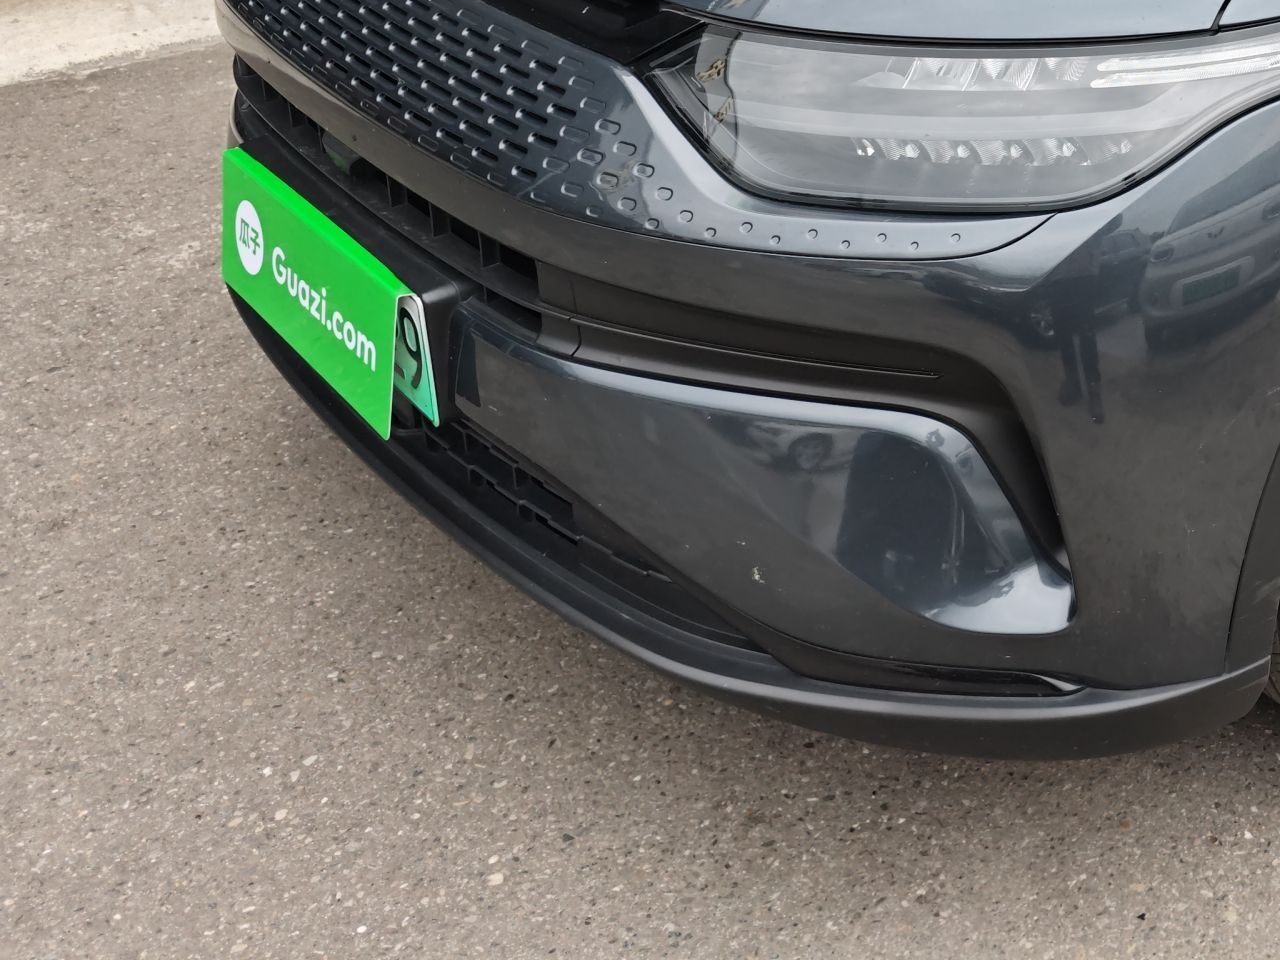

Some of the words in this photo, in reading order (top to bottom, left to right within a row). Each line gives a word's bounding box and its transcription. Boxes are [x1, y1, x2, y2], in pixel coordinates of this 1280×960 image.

[238, 217, 261, 256] 瓜子
[271, 246, 377, 372] Guazi.com
[394, 306, 423, 389] 9
